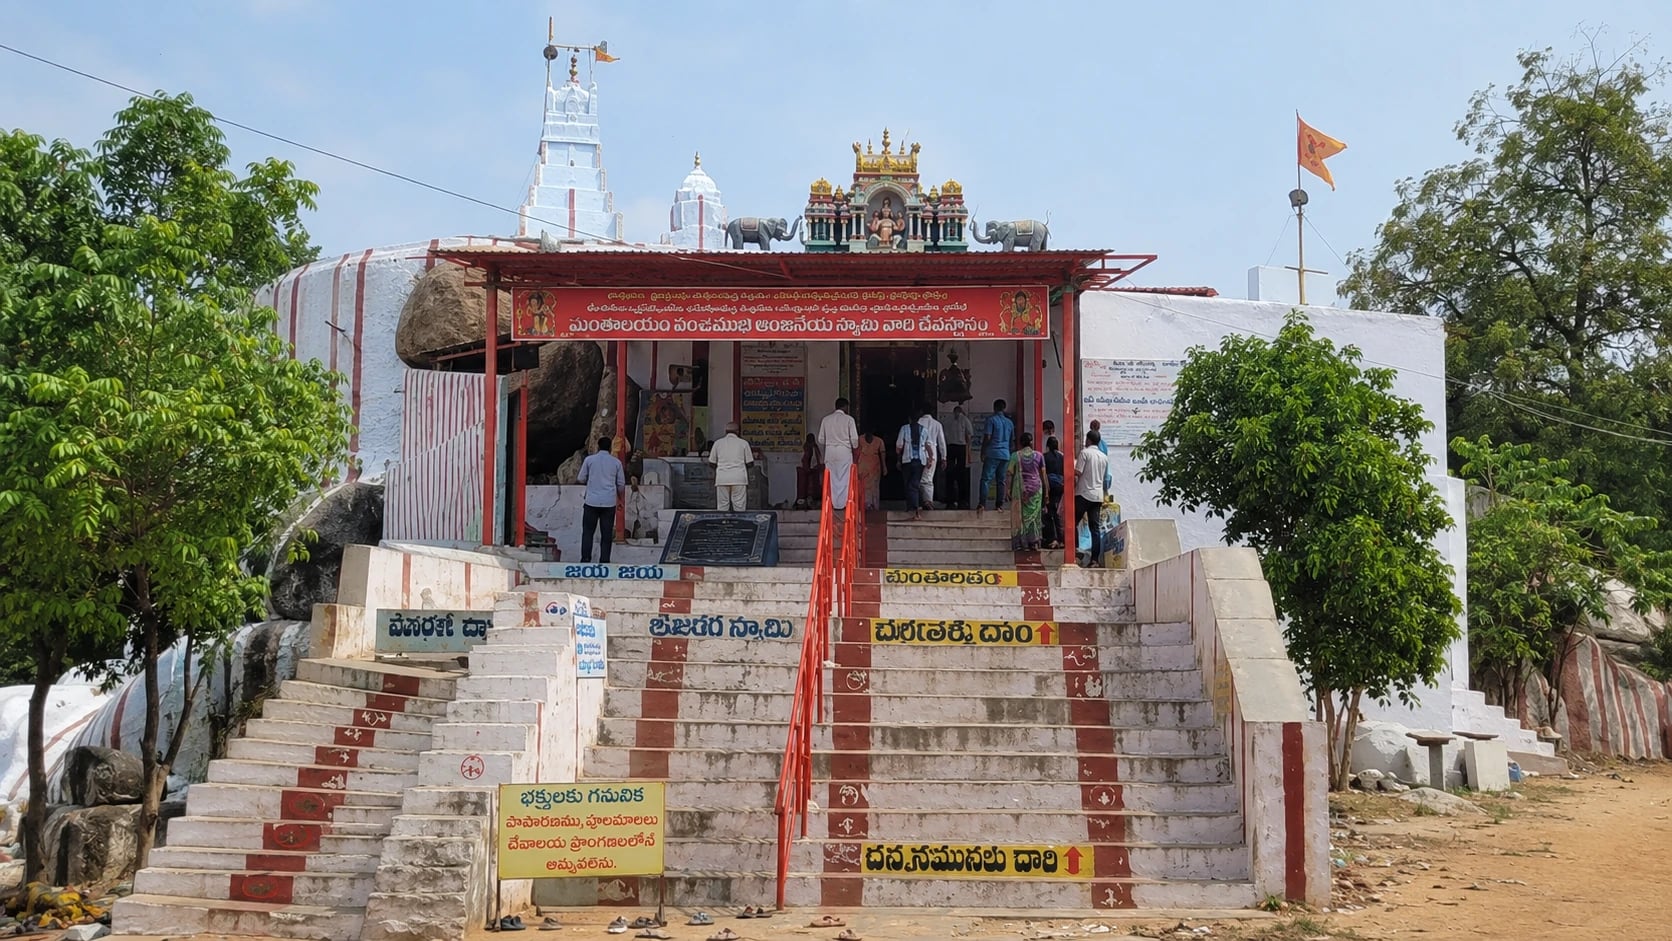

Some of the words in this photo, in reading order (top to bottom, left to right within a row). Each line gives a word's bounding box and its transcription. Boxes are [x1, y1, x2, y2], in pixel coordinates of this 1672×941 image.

[565, 564, 609, 578] జయ
[618, 565, 664, 579] జయ
[521, 789, 583, 810] భక్తులకు
[508, 834, 567, 850] దేవాలయ
